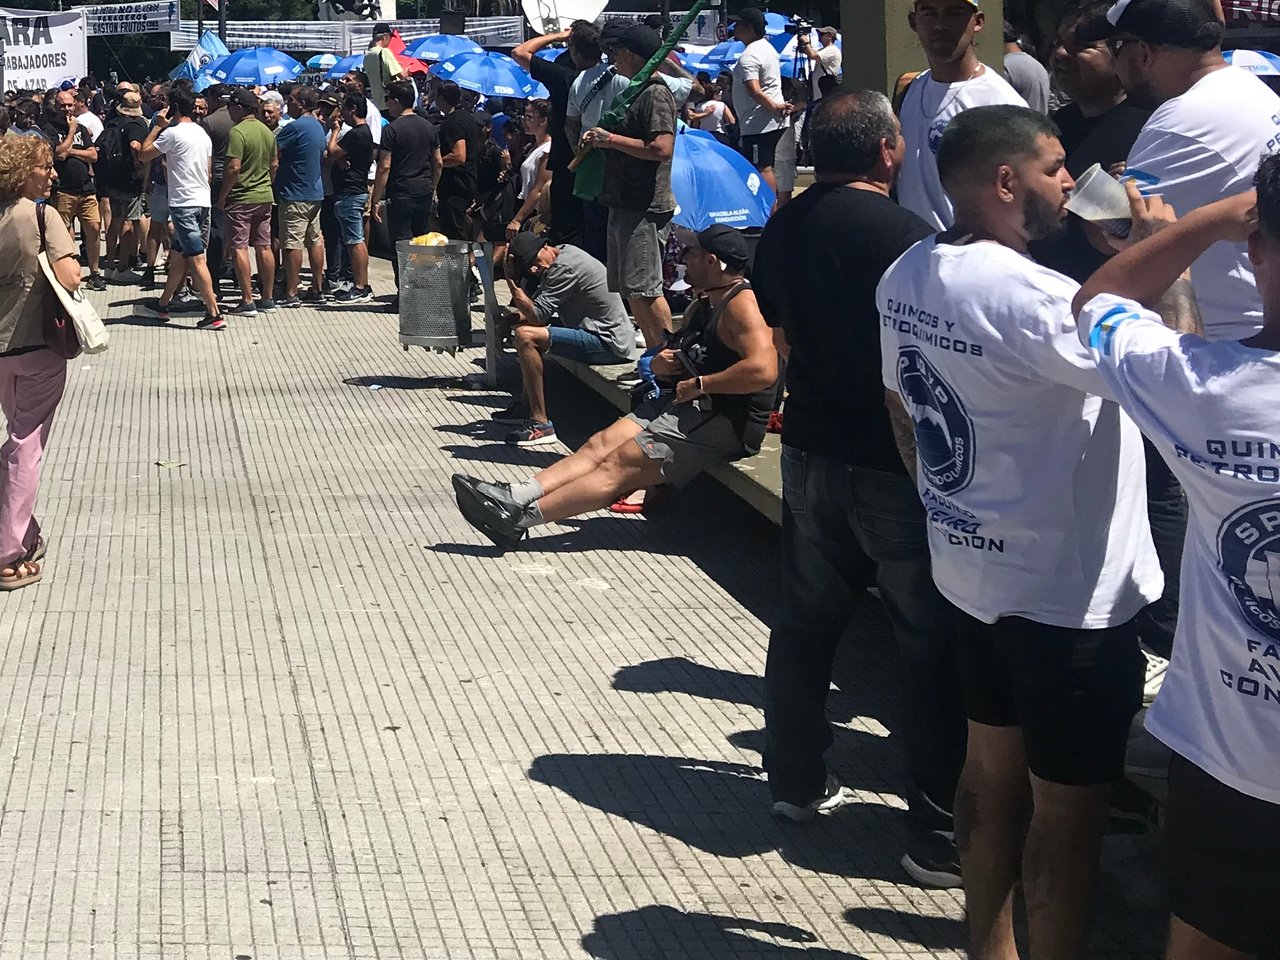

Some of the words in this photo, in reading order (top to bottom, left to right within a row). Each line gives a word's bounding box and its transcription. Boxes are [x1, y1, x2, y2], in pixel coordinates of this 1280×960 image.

[92, 23, 118, 34] GASTON
[120, 21, 146, 33] FRUTOS
[3, 52, 67, 72] RABAJADORES
[945, 320, 955, 332] Y
